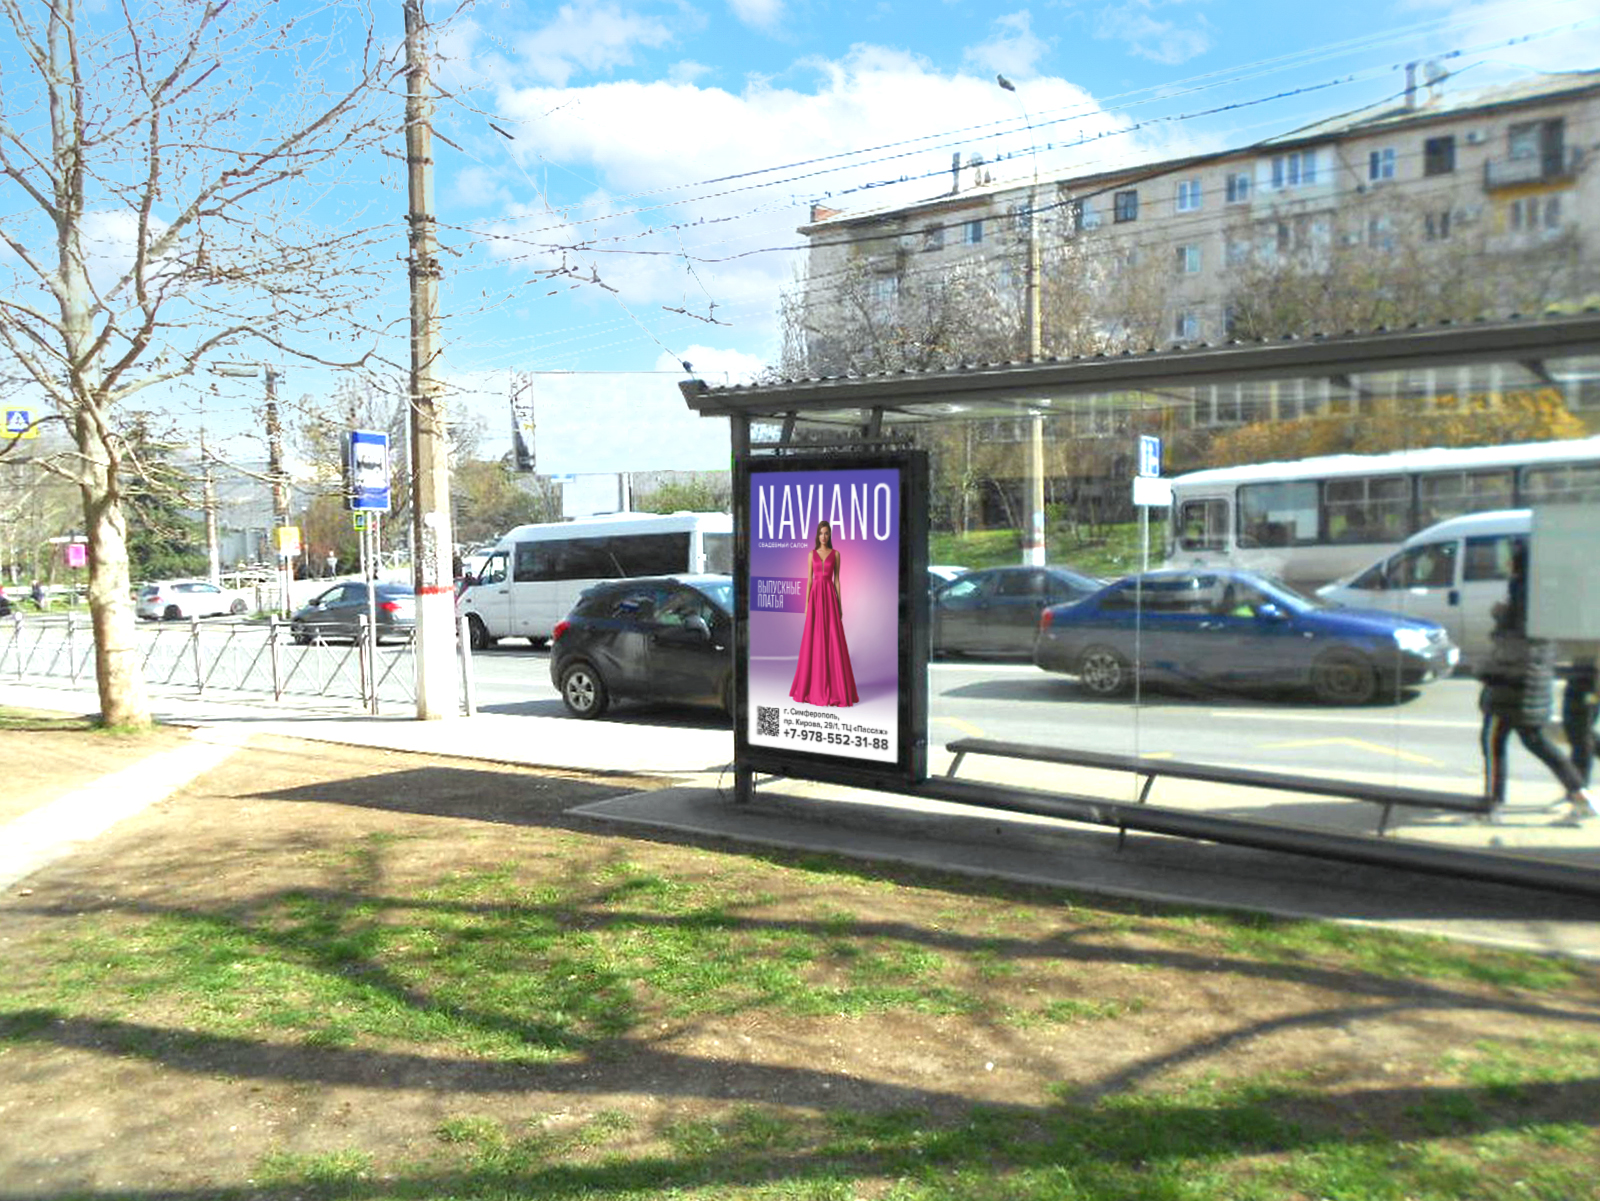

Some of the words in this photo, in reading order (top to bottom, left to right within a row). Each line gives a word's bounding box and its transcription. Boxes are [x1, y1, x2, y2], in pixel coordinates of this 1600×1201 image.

[758, 483, 891, 541] NAVIANO
[757, 579, 802, 595] ВЫПУСКНЫЕ
[757, 593, 784, 609] ПЛАТЬЯ
[790, 708, 840, 720] Симферополь,
[795, 719, 823, 730] Кирова,
[841, 723, 852, 732] ТЦ
[783, 728, 889, 750] +7-978-552-31-88
